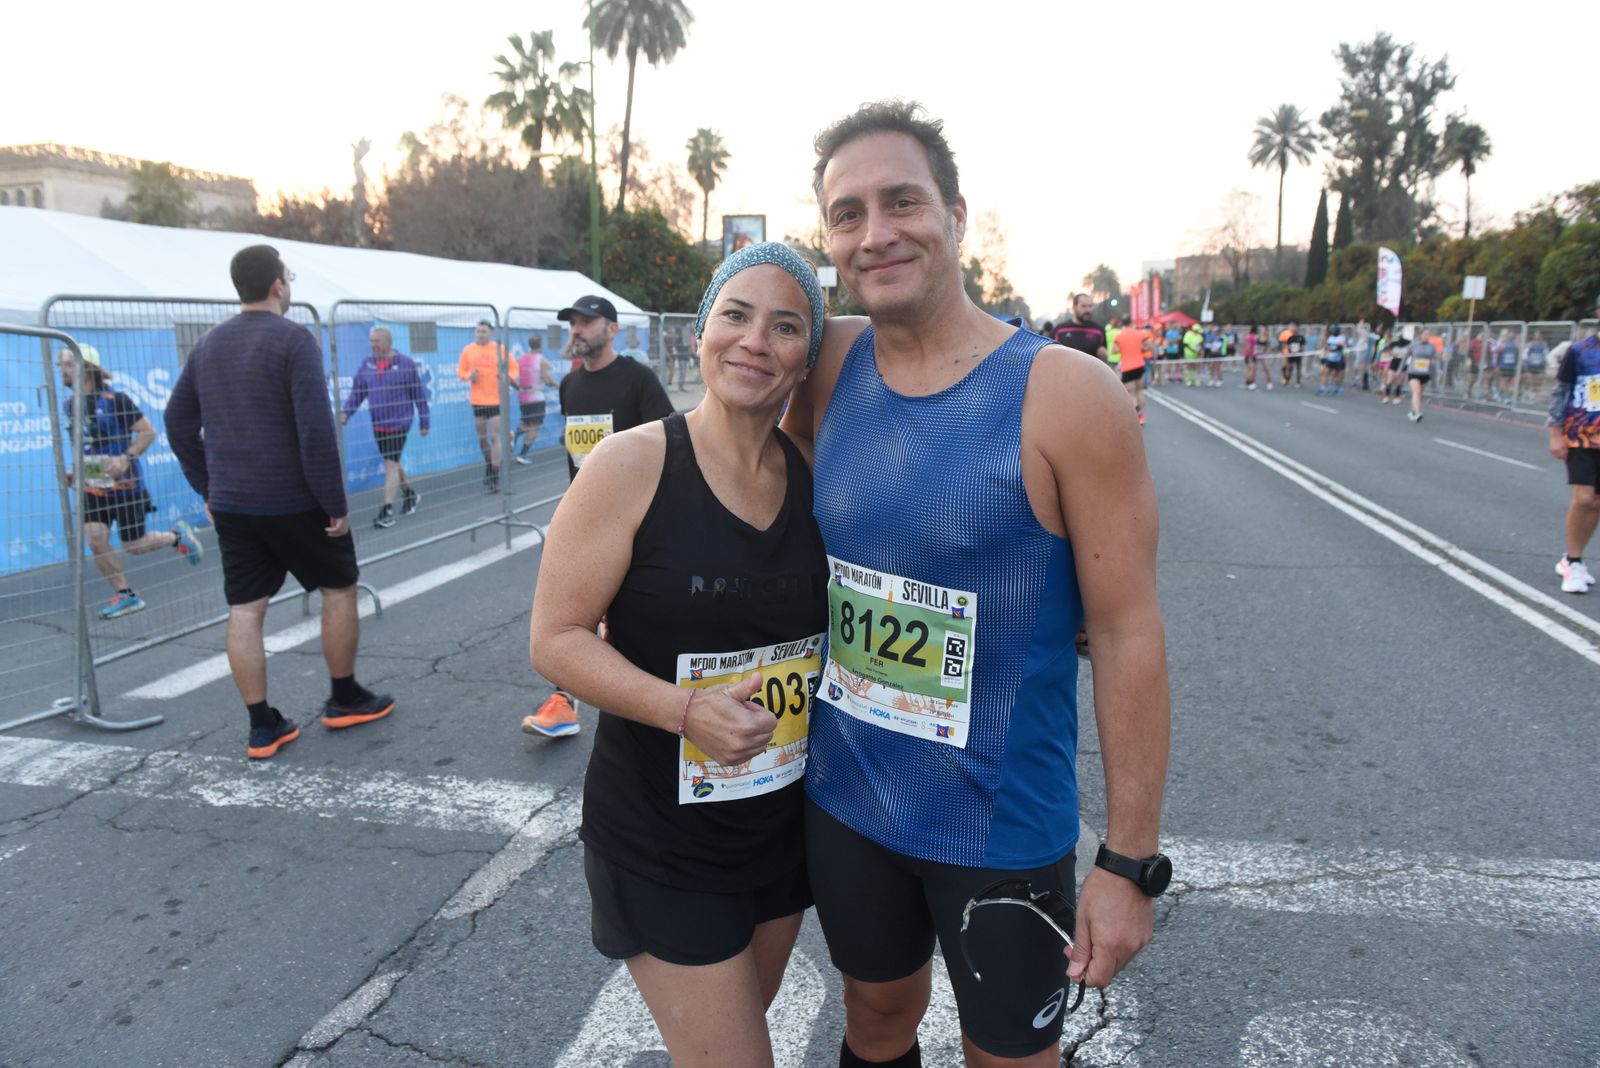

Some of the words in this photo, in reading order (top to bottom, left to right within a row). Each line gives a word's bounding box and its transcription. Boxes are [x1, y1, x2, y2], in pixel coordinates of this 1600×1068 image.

[568, 428, 604, 445] 10006
[850, 567, 882, 590] MARATÓN
[902, 580, 949, 610] SEVILLA
[840, 600, 929, 668] 8122
[690, 657, 717, 670] MEDIO
[720, 649, 755, 669] MARATÓN
[771, 639, 809, 661] SEVILLA
[870, 657, 884, 667] FER
[869, 706, 891, 720] HOKA
[752, 774, 774, 787] HOKA
